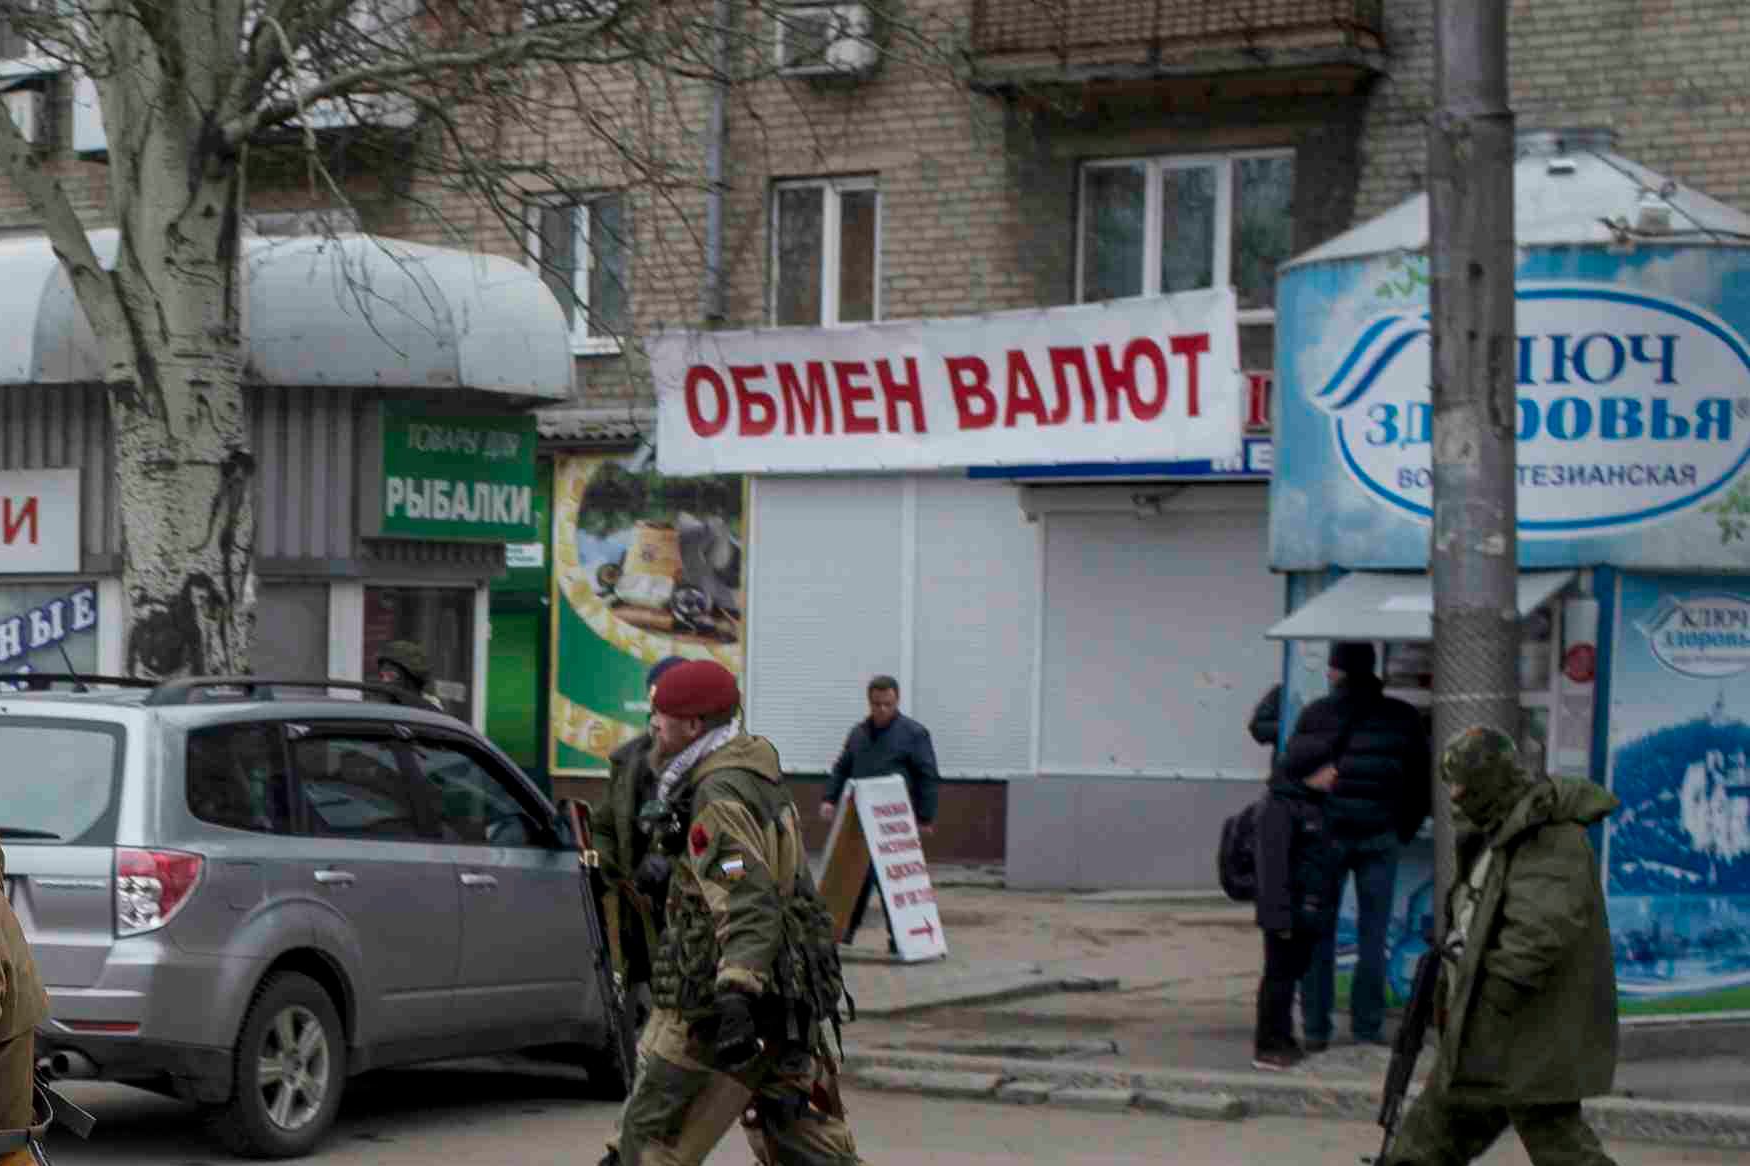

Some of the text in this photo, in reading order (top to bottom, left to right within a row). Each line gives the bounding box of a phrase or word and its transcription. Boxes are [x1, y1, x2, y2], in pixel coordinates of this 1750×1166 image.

[1515, 333, 1680, 386] ЮЧ
[683, 355, 929, 439] ОБМЕН
[943, 332, 1211, 431] ВАЛЮТ
[385, 476, 532, 526] РЫБАЛКИ
[1515, 463, 1697, 489] ТЕЗИАНСКАЯ
